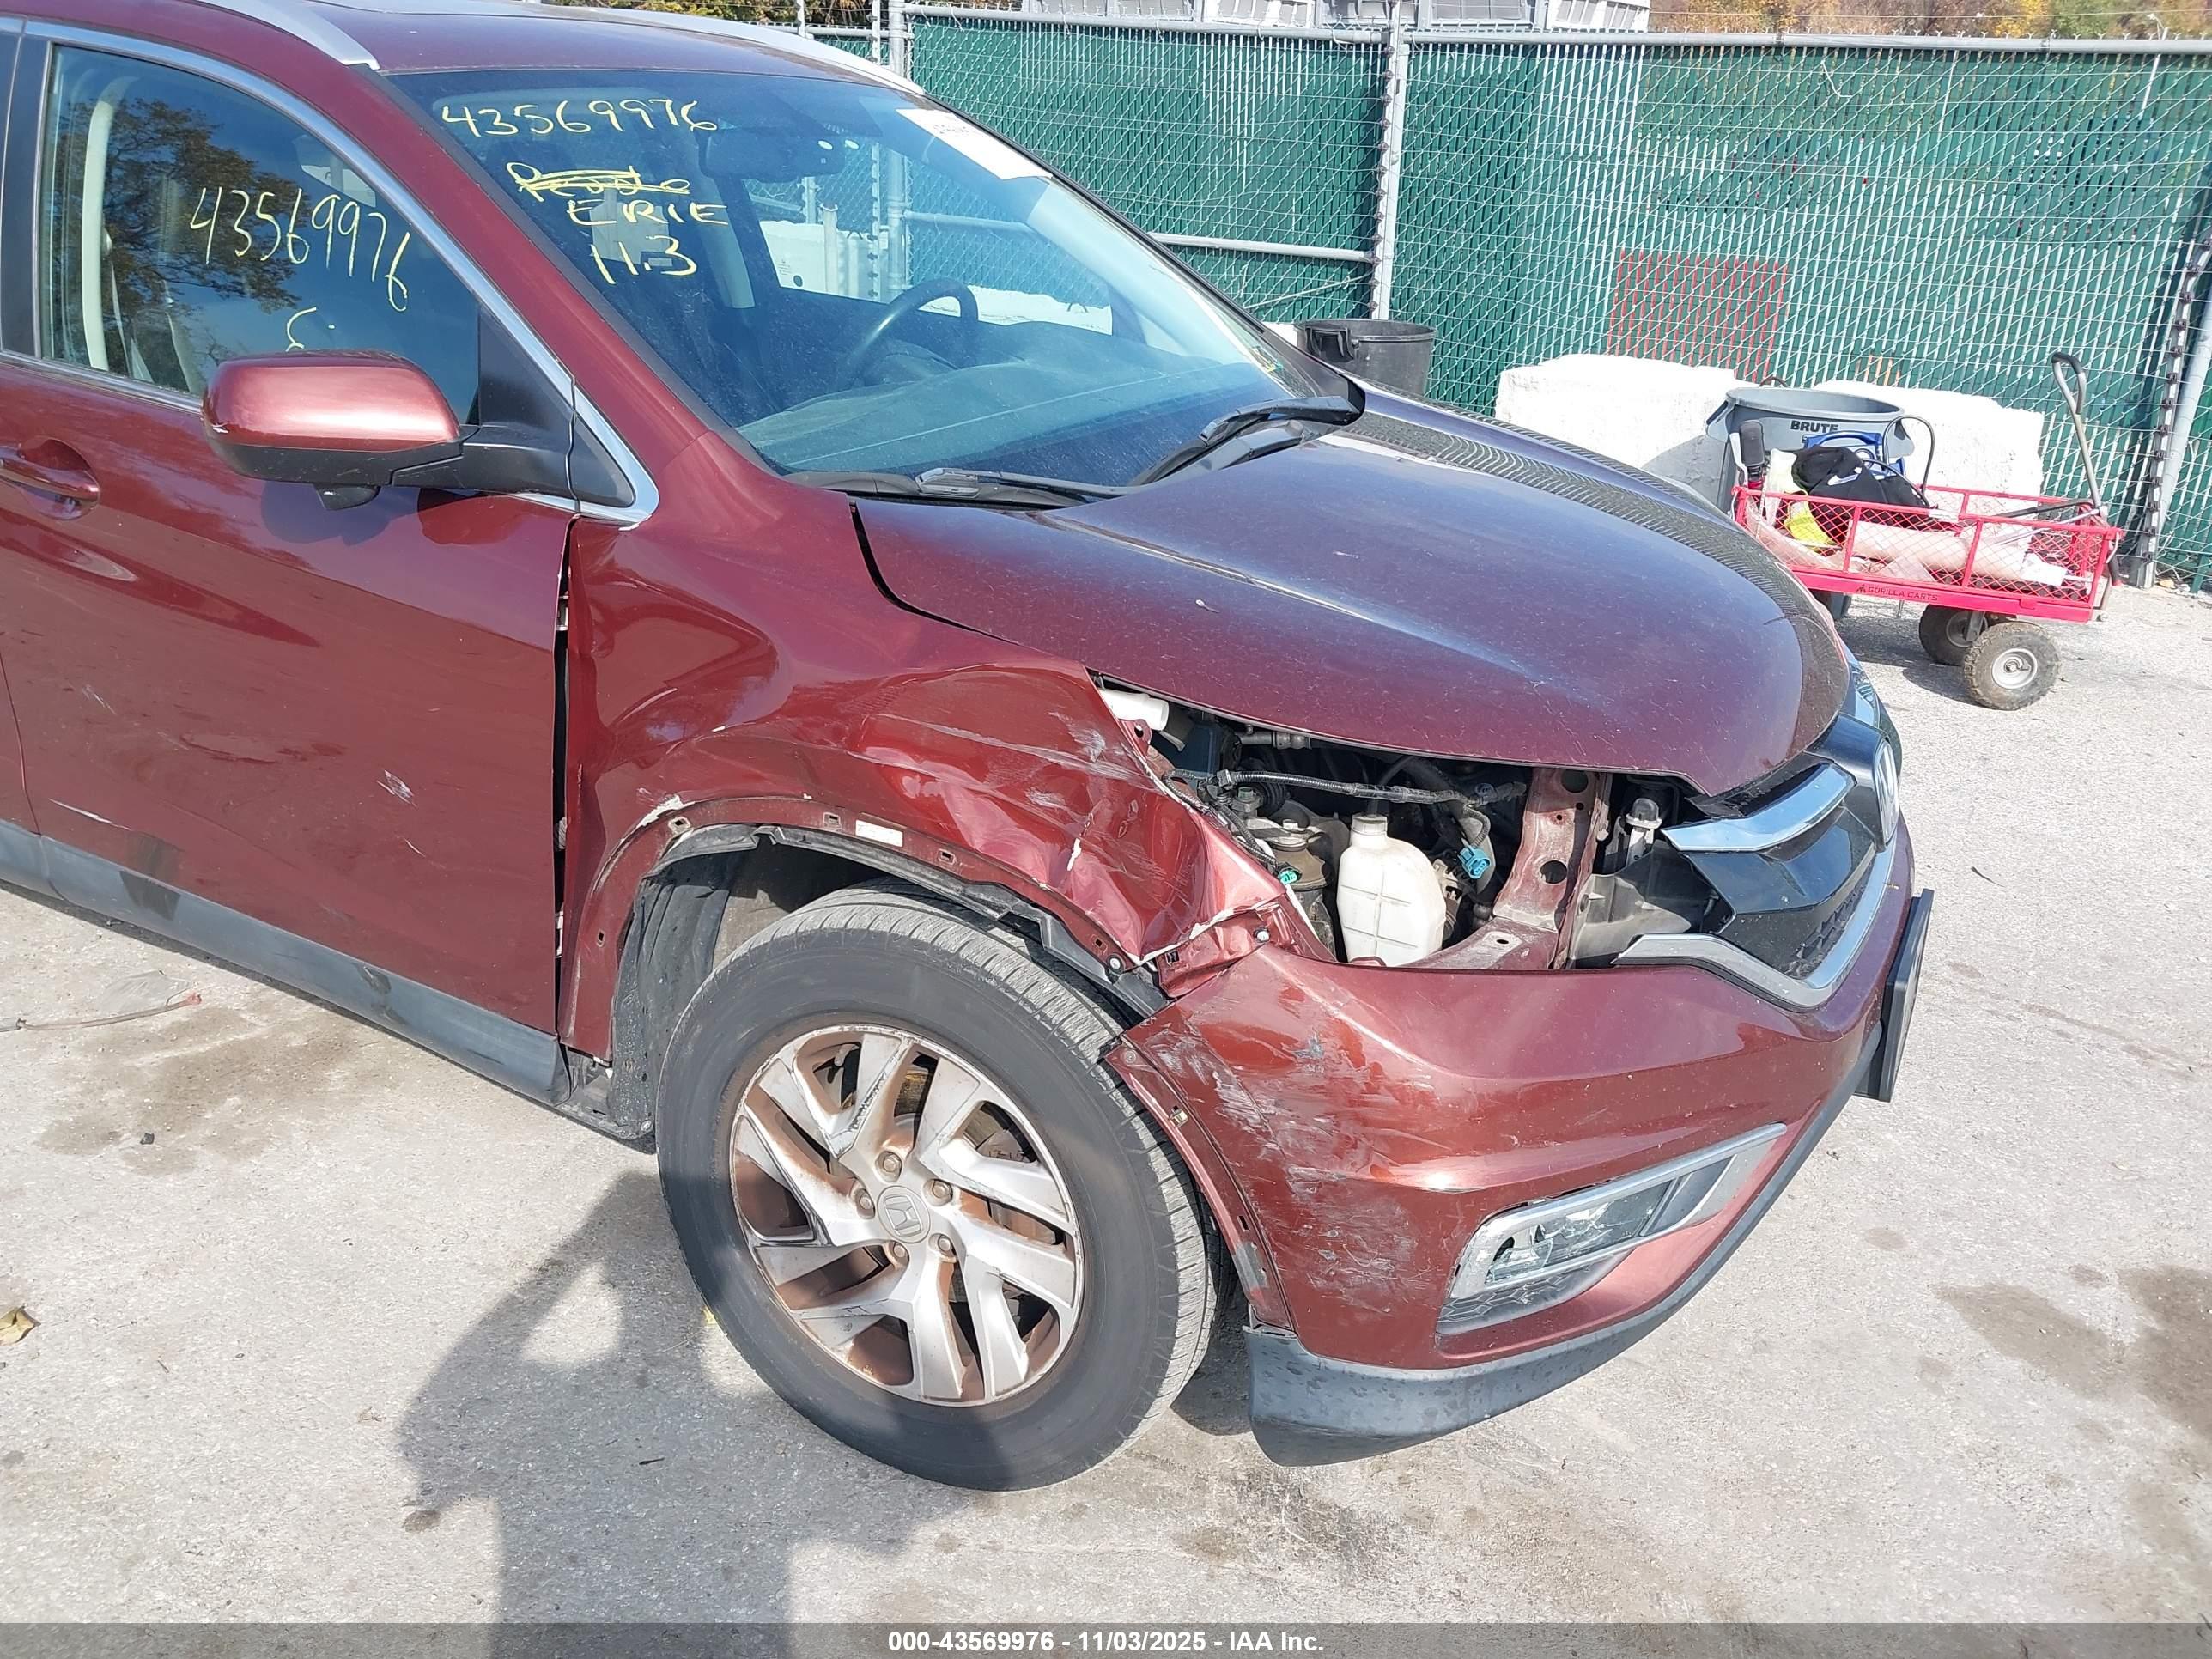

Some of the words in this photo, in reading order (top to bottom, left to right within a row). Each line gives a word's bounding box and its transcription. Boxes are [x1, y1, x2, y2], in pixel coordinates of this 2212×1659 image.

[441, 99, 719, 138] 43569976
[566, 198, 730, 226] ERIE
[189, 185, 410, 313] 43569976
[1790, 420, 1839, 434] BRUTE
[1868, 586, 1905, 599] GORILLA
[1906, 591, 1939, 601] CARTS
